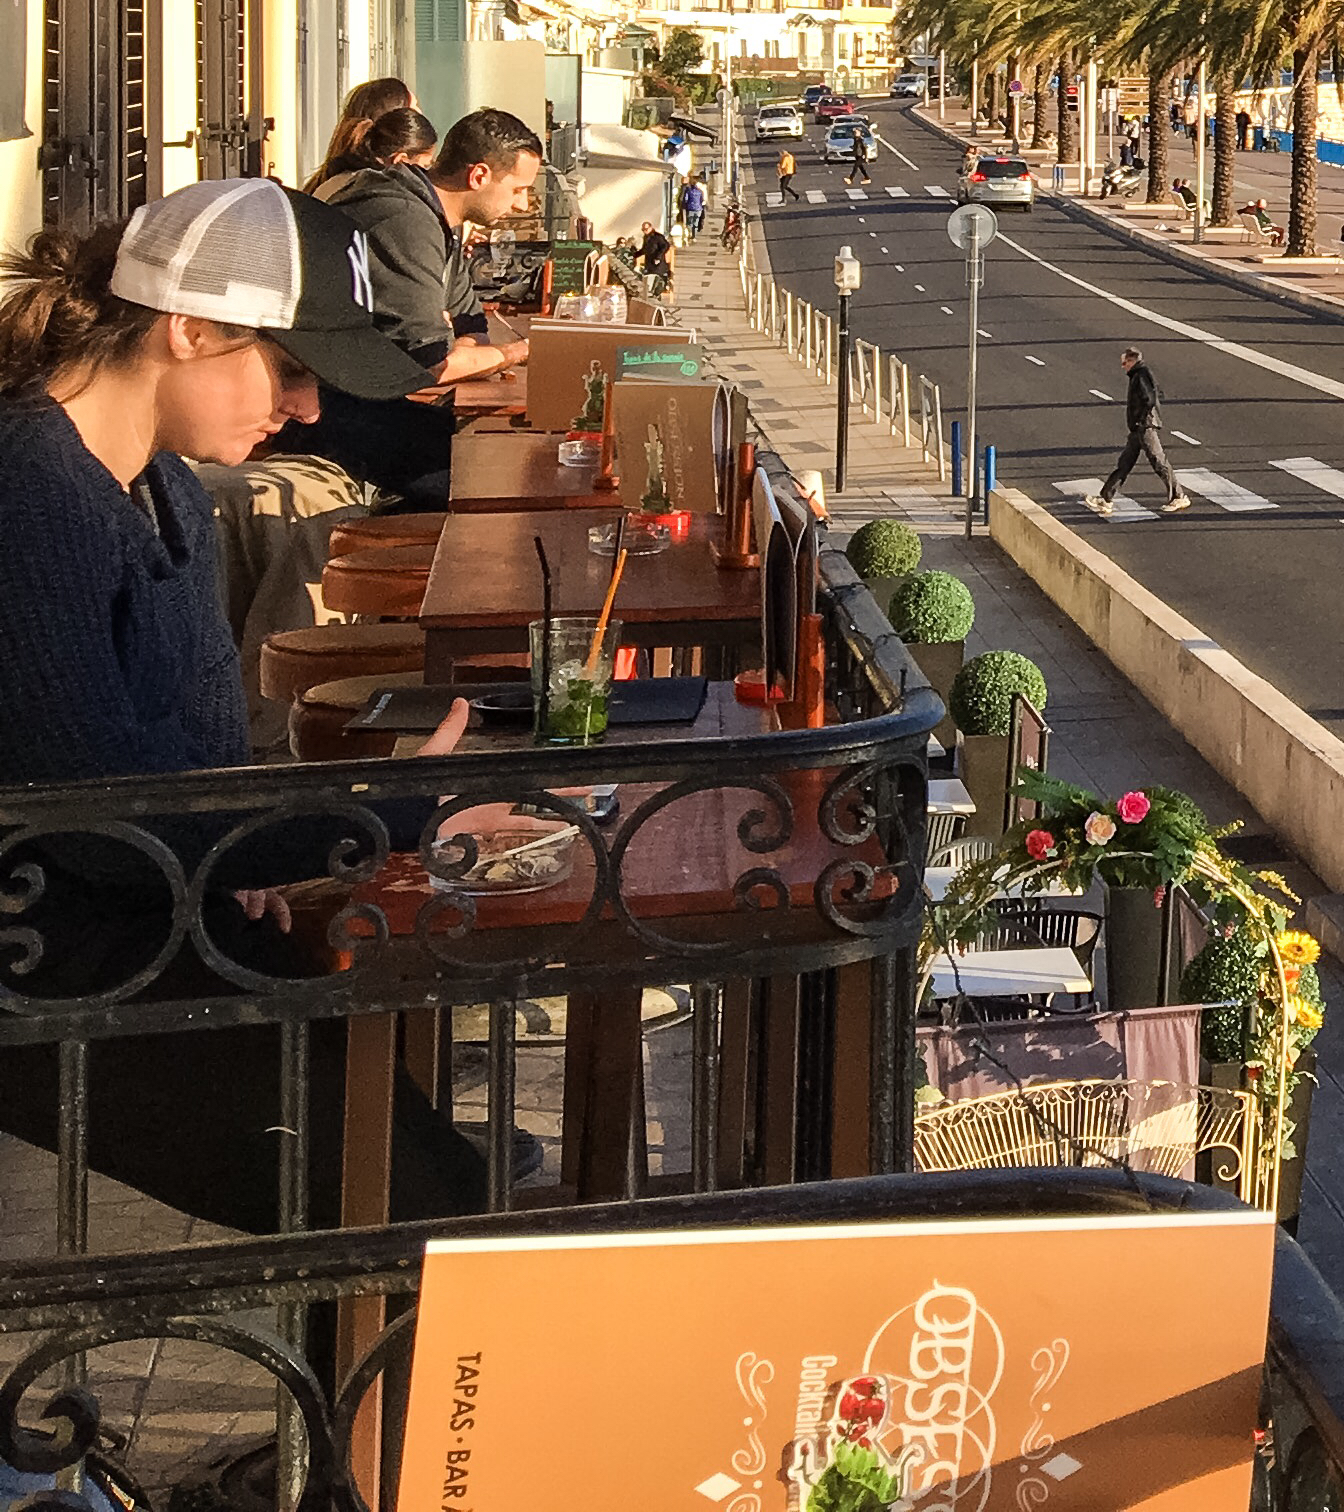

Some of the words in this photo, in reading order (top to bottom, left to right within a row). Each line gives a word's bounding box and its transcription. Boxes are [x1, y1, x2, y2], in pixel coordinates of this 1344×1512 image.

[450, 1351, 482, 1432] TAPAS
[899, 1278, 978, 1512] OBSES
[442, 1449, 471, 1500] BAR
